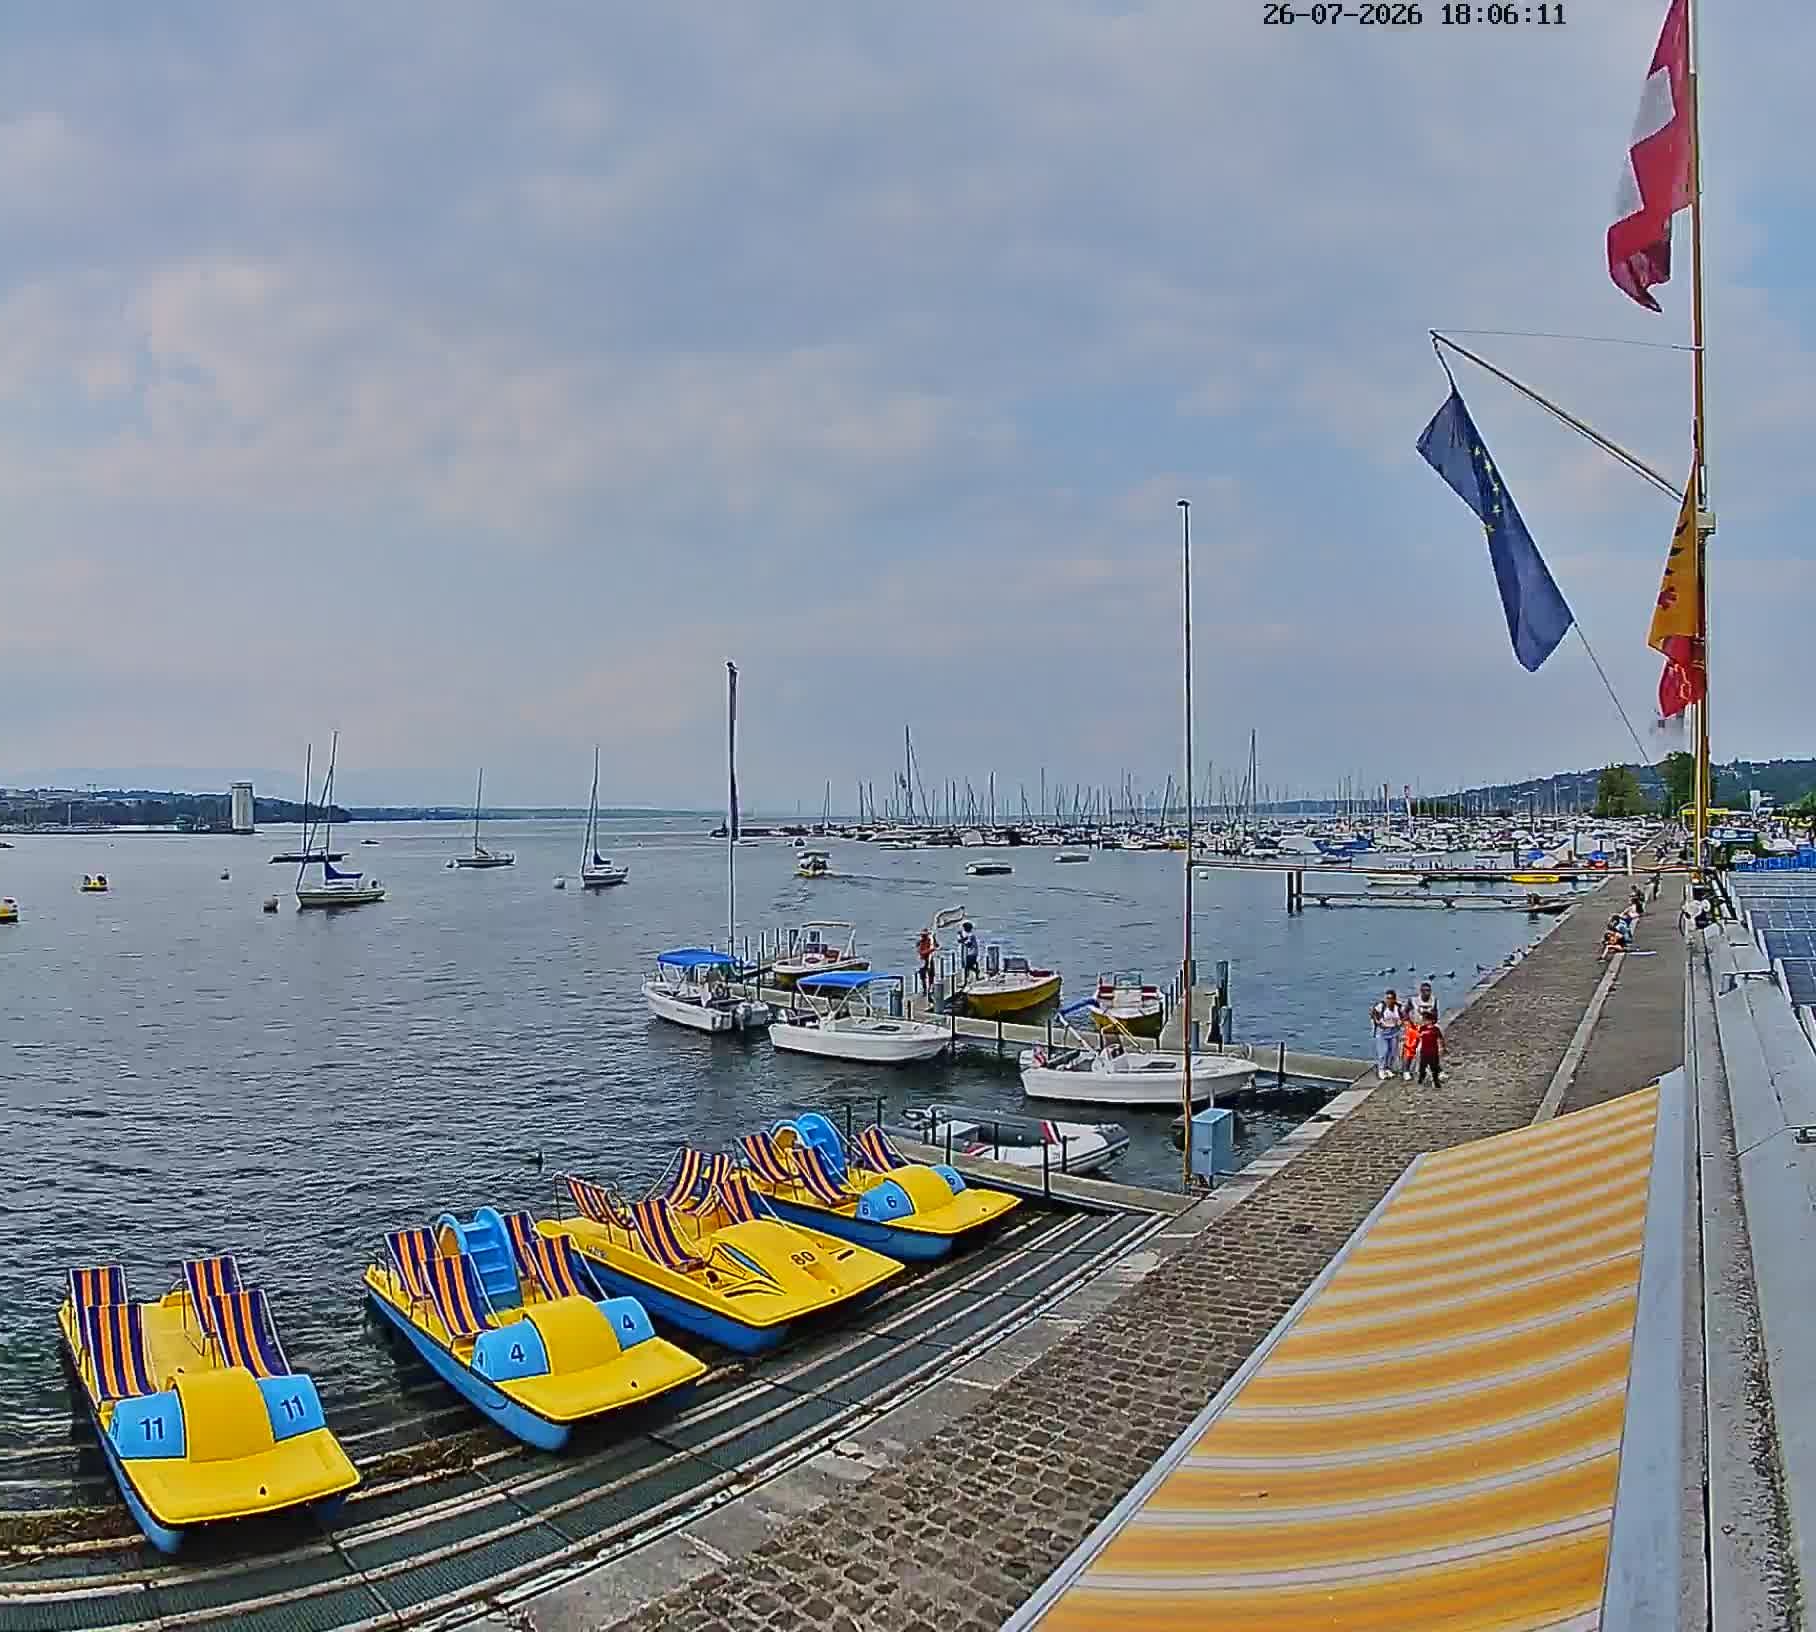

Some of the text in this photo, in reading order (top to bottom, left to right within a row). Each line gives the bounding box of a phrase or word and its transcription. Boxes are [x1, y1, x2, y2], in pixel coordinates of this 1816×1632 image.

[886, 1195, 897, 1209] 6
[790, 1251, 816, 1266] 80
[622, 1314, 635, 1331] 4
[510, 1343, 525, 1363] 4
[280, 1394, 305, 1420] 11
[139, 1416, 165, 1441] 11
